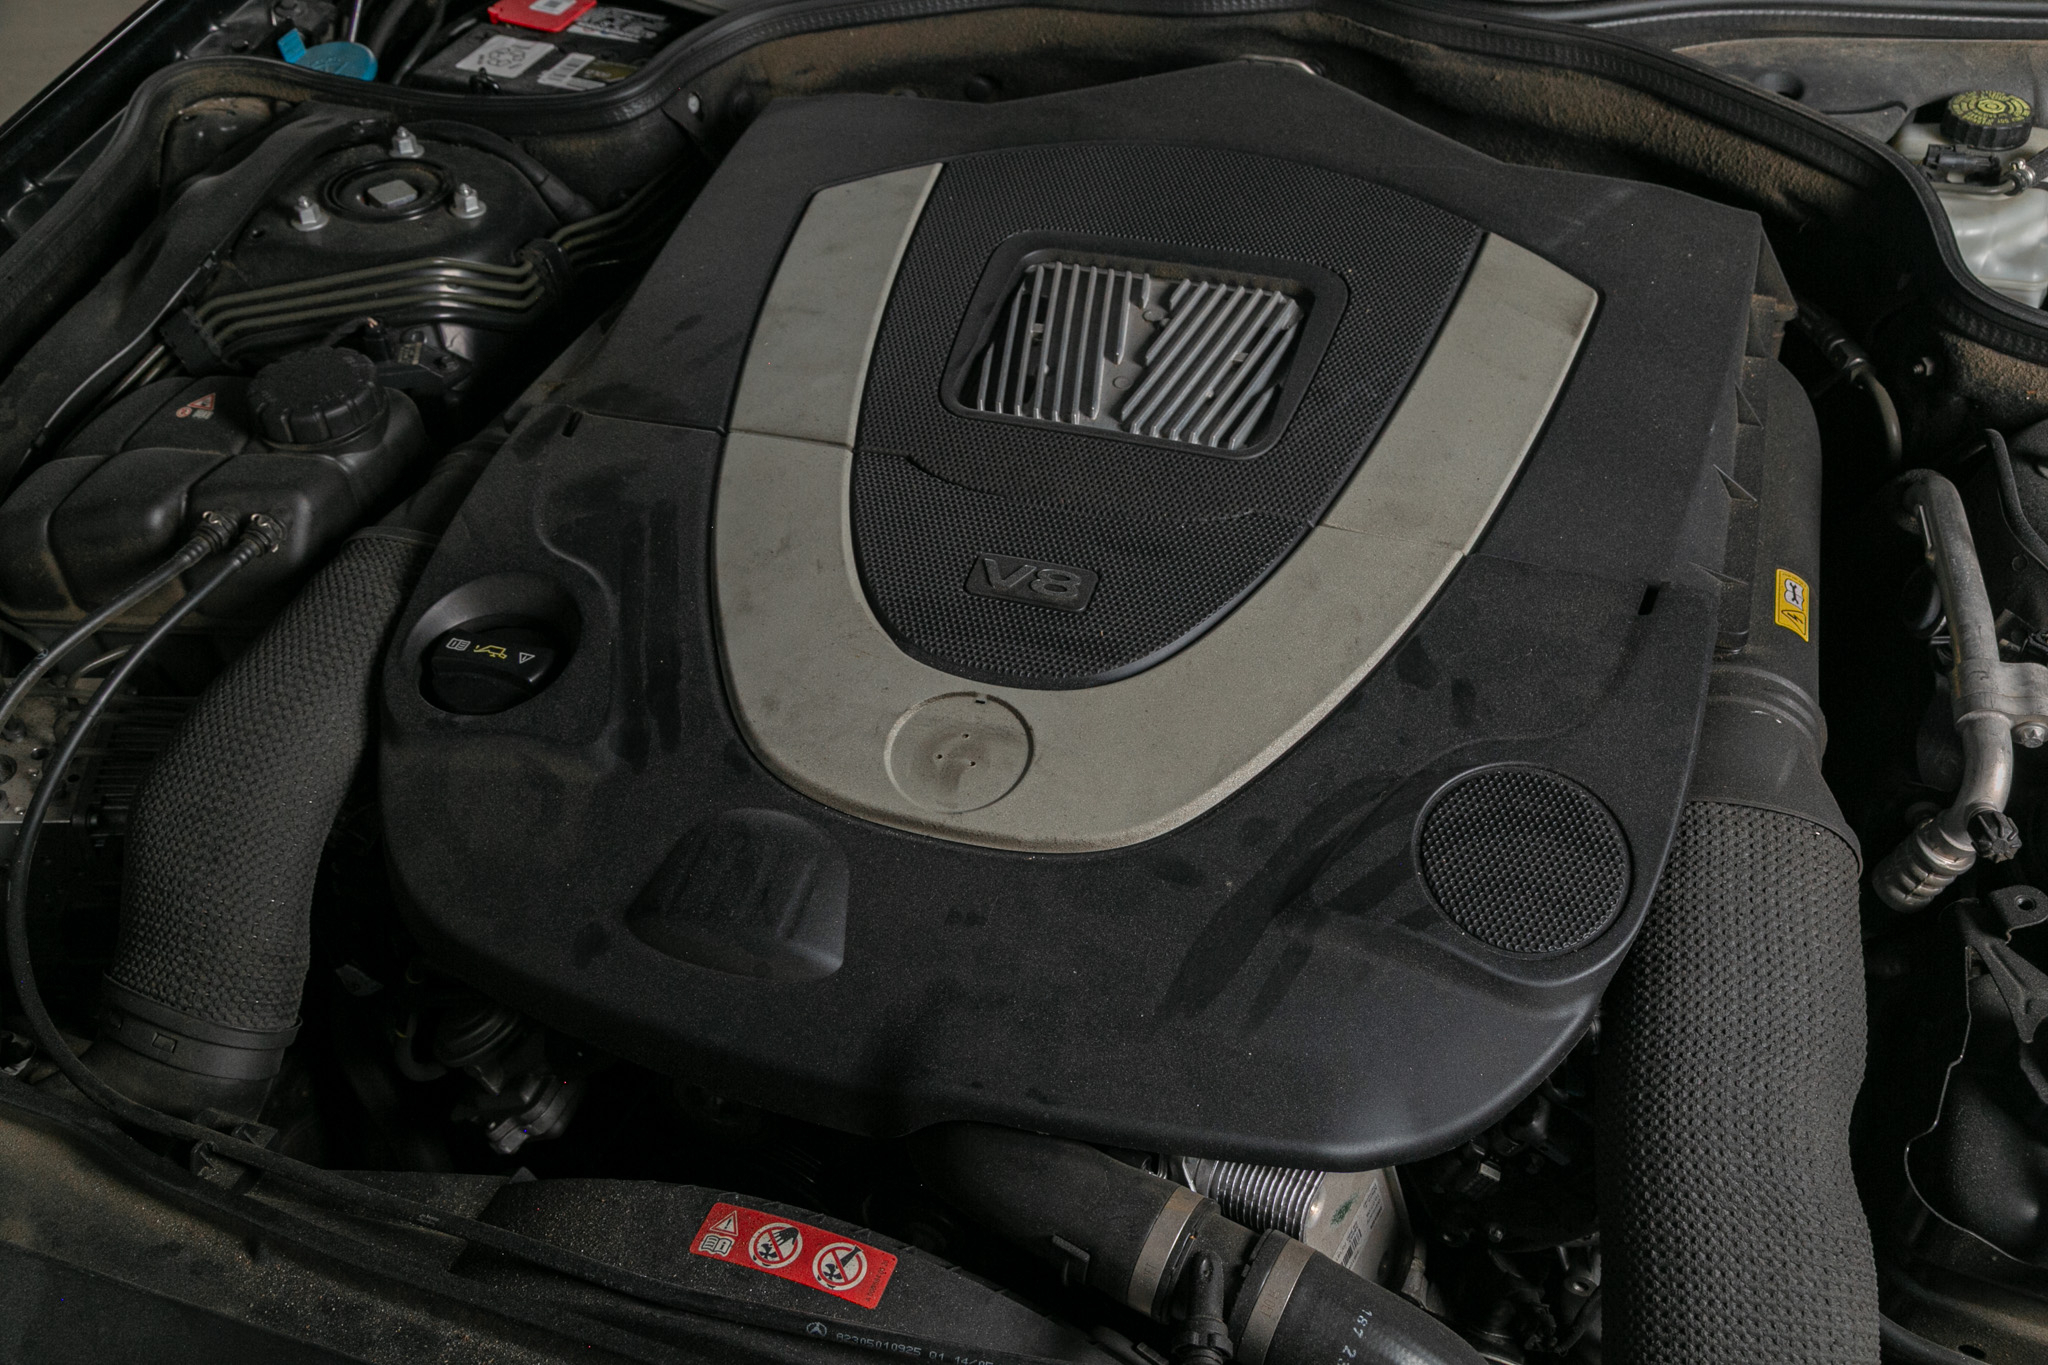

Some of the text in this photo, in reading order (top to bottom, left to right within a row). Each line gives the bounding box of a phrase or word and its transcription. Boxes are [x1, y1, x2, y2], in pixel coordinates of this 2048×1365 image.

[984, 557, 1083, 600] V8
[1352, 1309, 1373, 1339] 187
[836, 1333, 921, 1356] A2305010925
